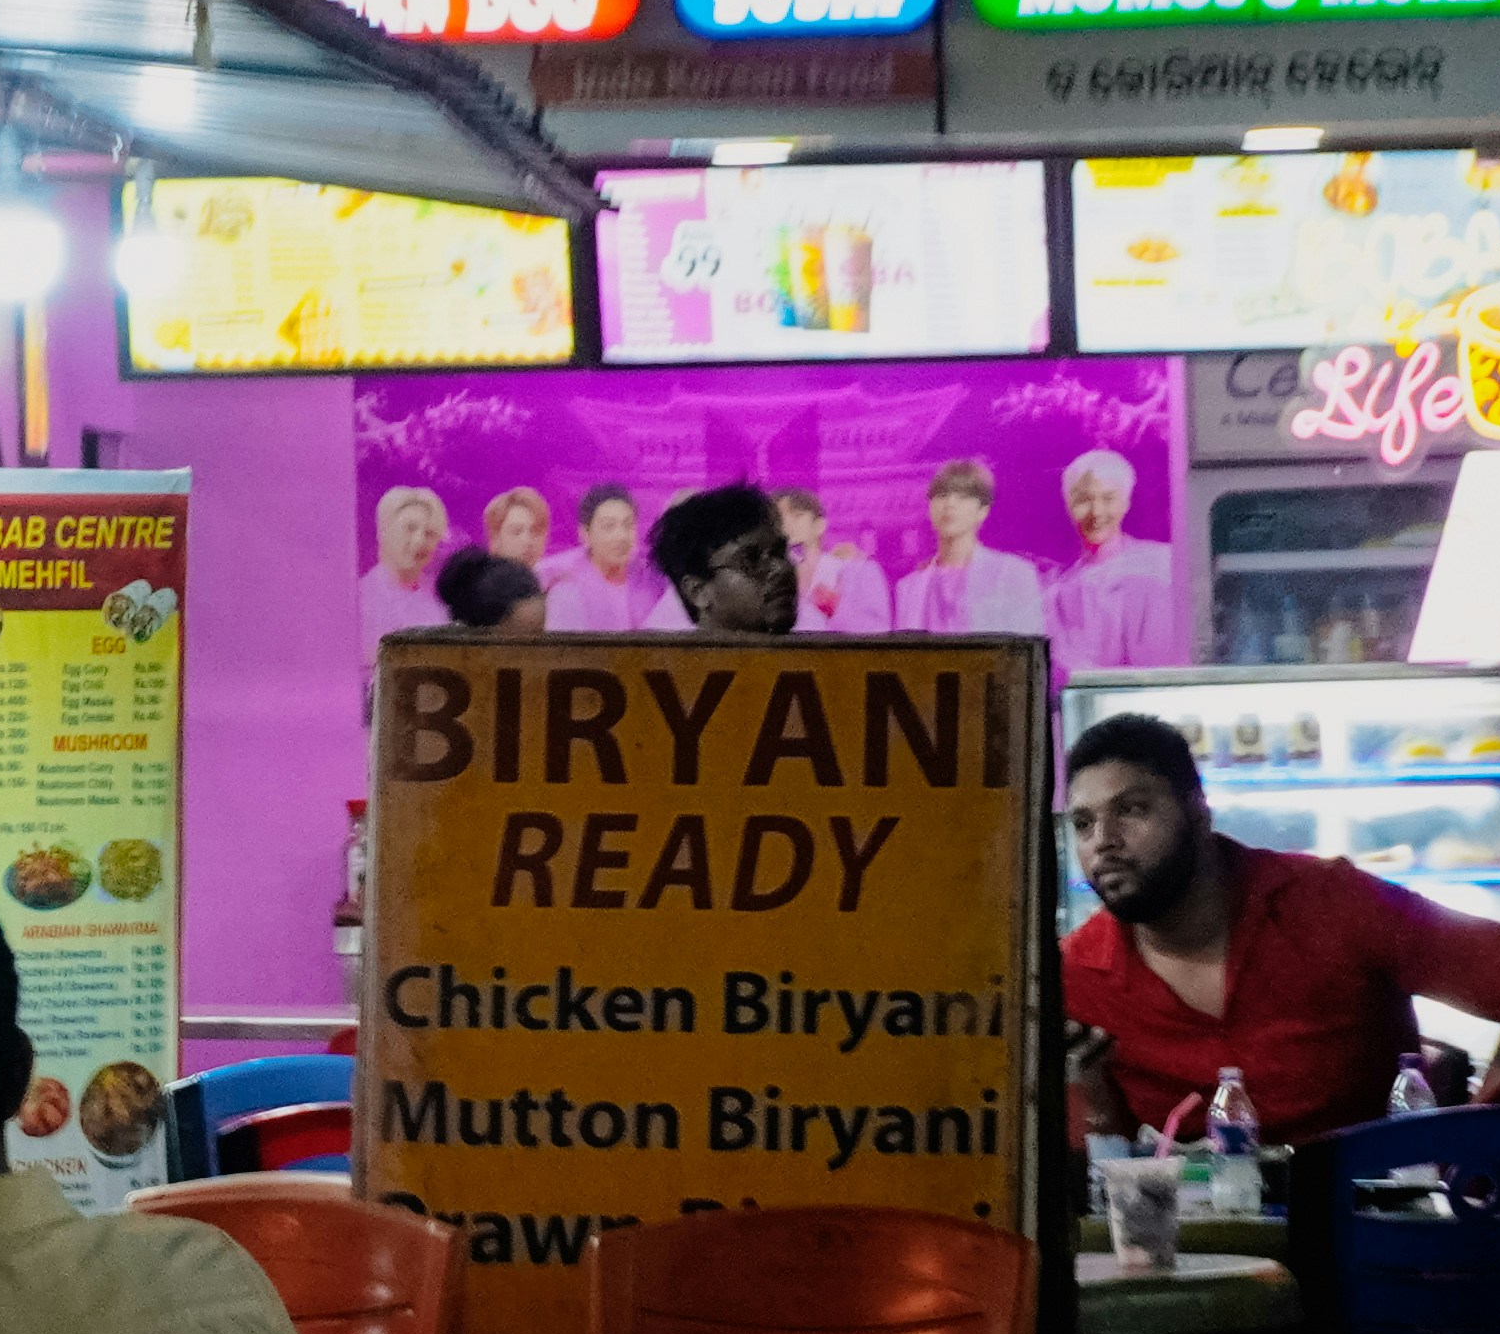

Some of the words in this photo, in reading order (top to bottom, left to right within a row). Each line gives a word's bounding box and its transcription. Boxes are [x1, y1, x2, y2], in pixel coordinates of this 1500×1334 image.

[55, 515, 175, 549] CENTRE
[91, 636, 126, 655] EGG
[53, 734, 148, 752] MUSHROOM
[398, 666, 1012, 789] BIRYANI
[490, 810, 900, 913] READY
[384, 965, 697, 1034] Chicken
[722, 970, 1004, 1054] Biryani
[379, 1079, 681, 1152] Mutton
[708, 1085, 1001, 1171] Biryani
